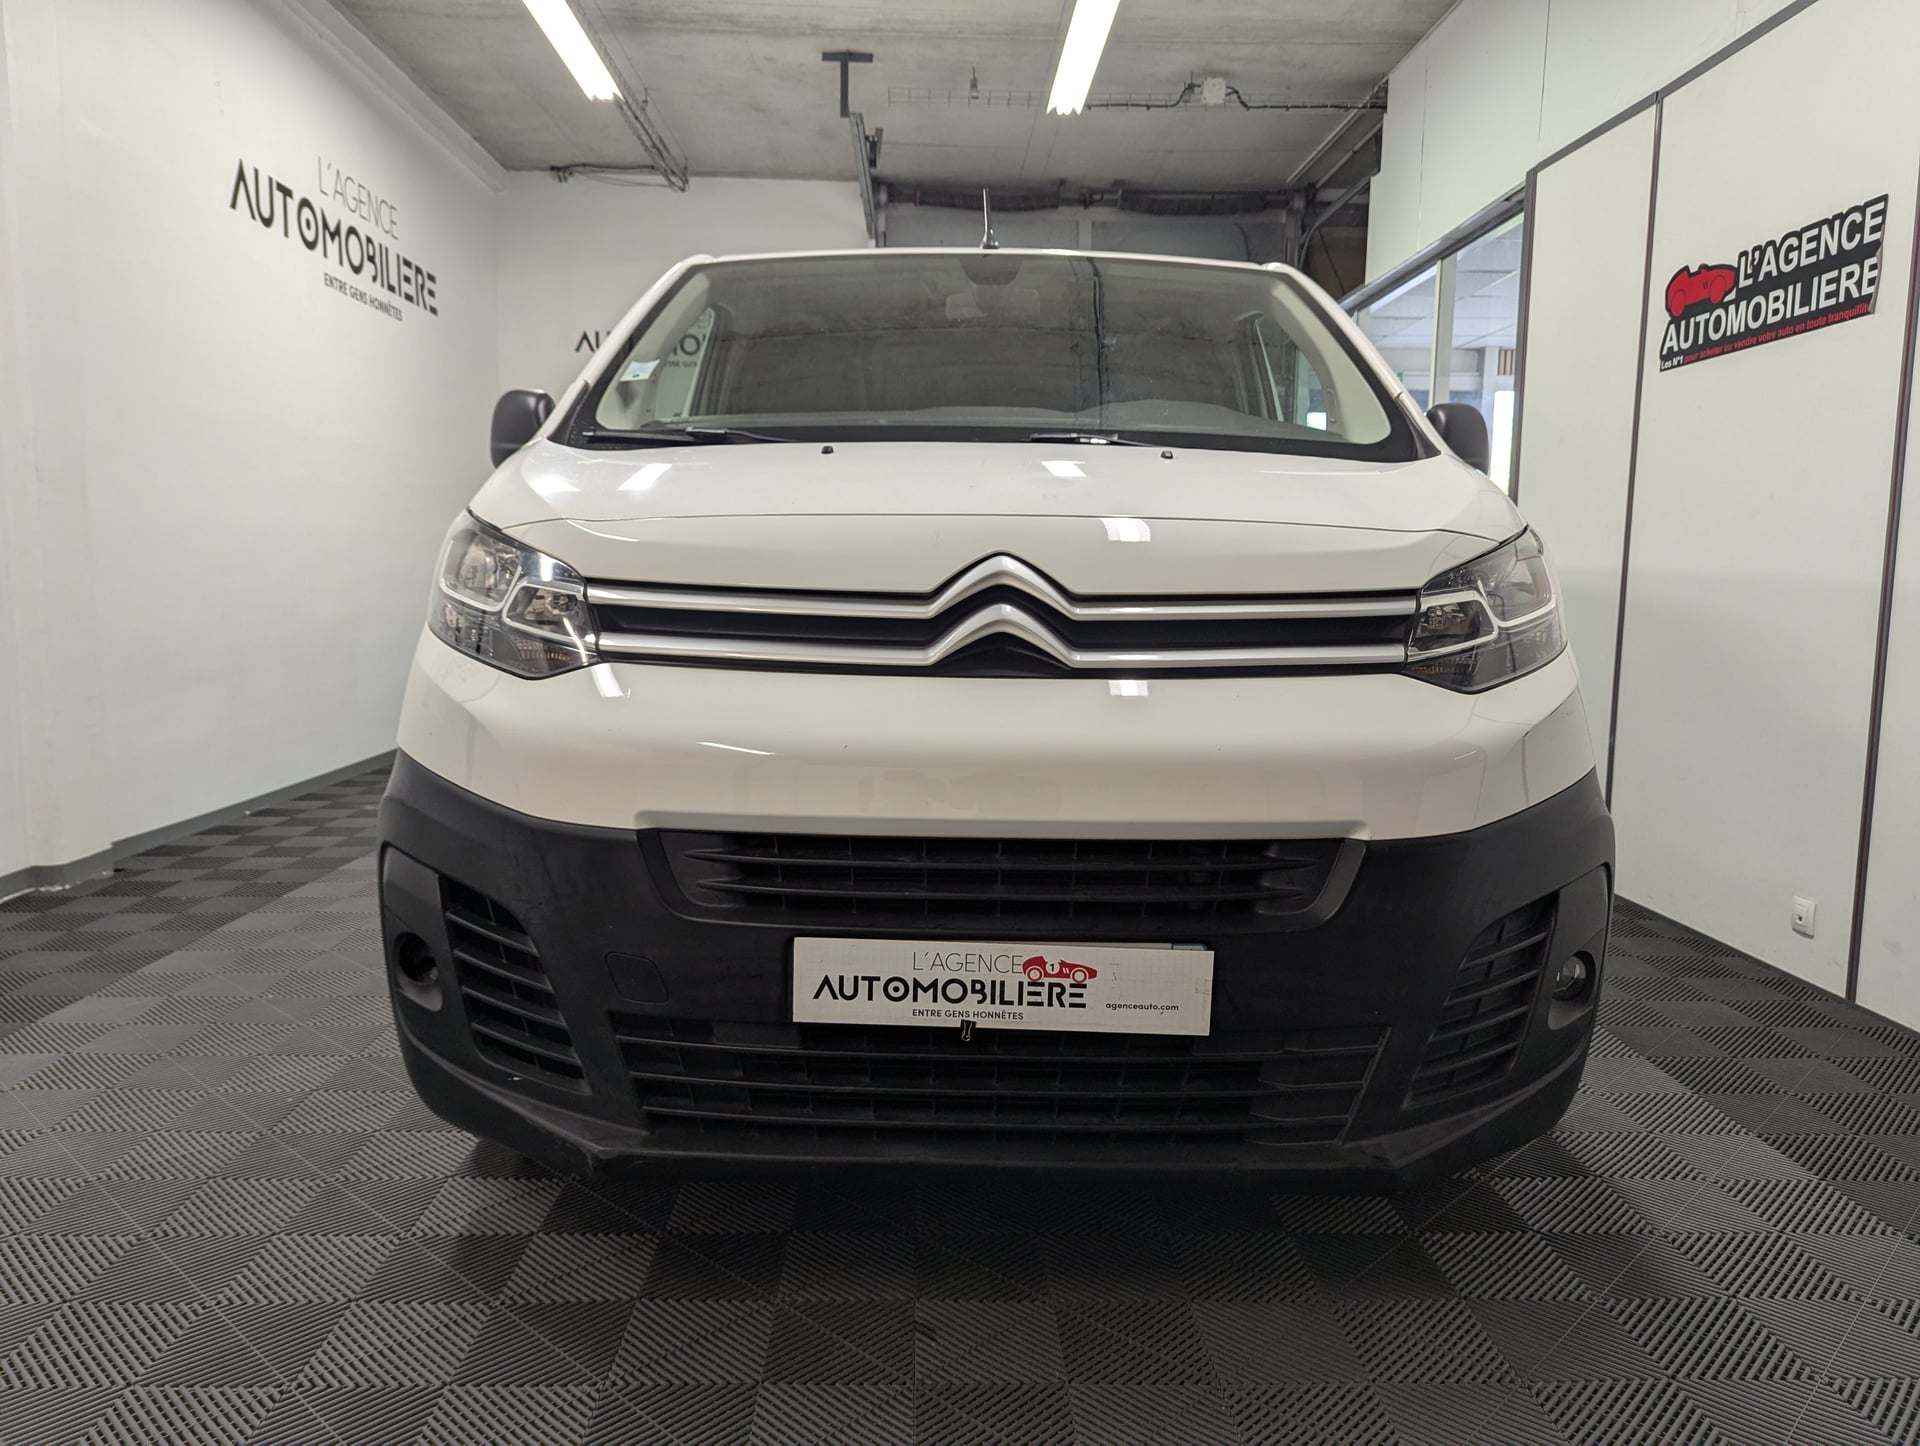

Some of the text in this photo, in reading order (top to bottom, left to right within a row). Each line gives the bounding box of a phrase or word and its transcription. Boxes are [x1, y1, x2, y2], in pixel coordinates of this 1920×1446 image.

[318, 156, 399, 240] L'AGENCE
[230, 158, 438, 316] AUTOMOBILIERE
[324, 272, 348, 296] ENTRE
[349, 285, 368, 305] GENS
[1662, 256, 1878, 355] AUTOMOBILIERE
[1734, 336, 1757, 349] vendre
[1758, 330, 1776, 342] votre
[1777, 325, 1794, 337] auto
[1795, 323, 1805, 333] en
[1807, 316, 1827, 330] toute
[913, 952, 1024, 974] L'AGENCE
[812, 974, 1088, 1009] AUTOMOBILIERE
[1105, 1001, 1179, 1011] agenceauto.com
[912, 1008, 1024, 1020] ENTRE GENS HONNÊTES
